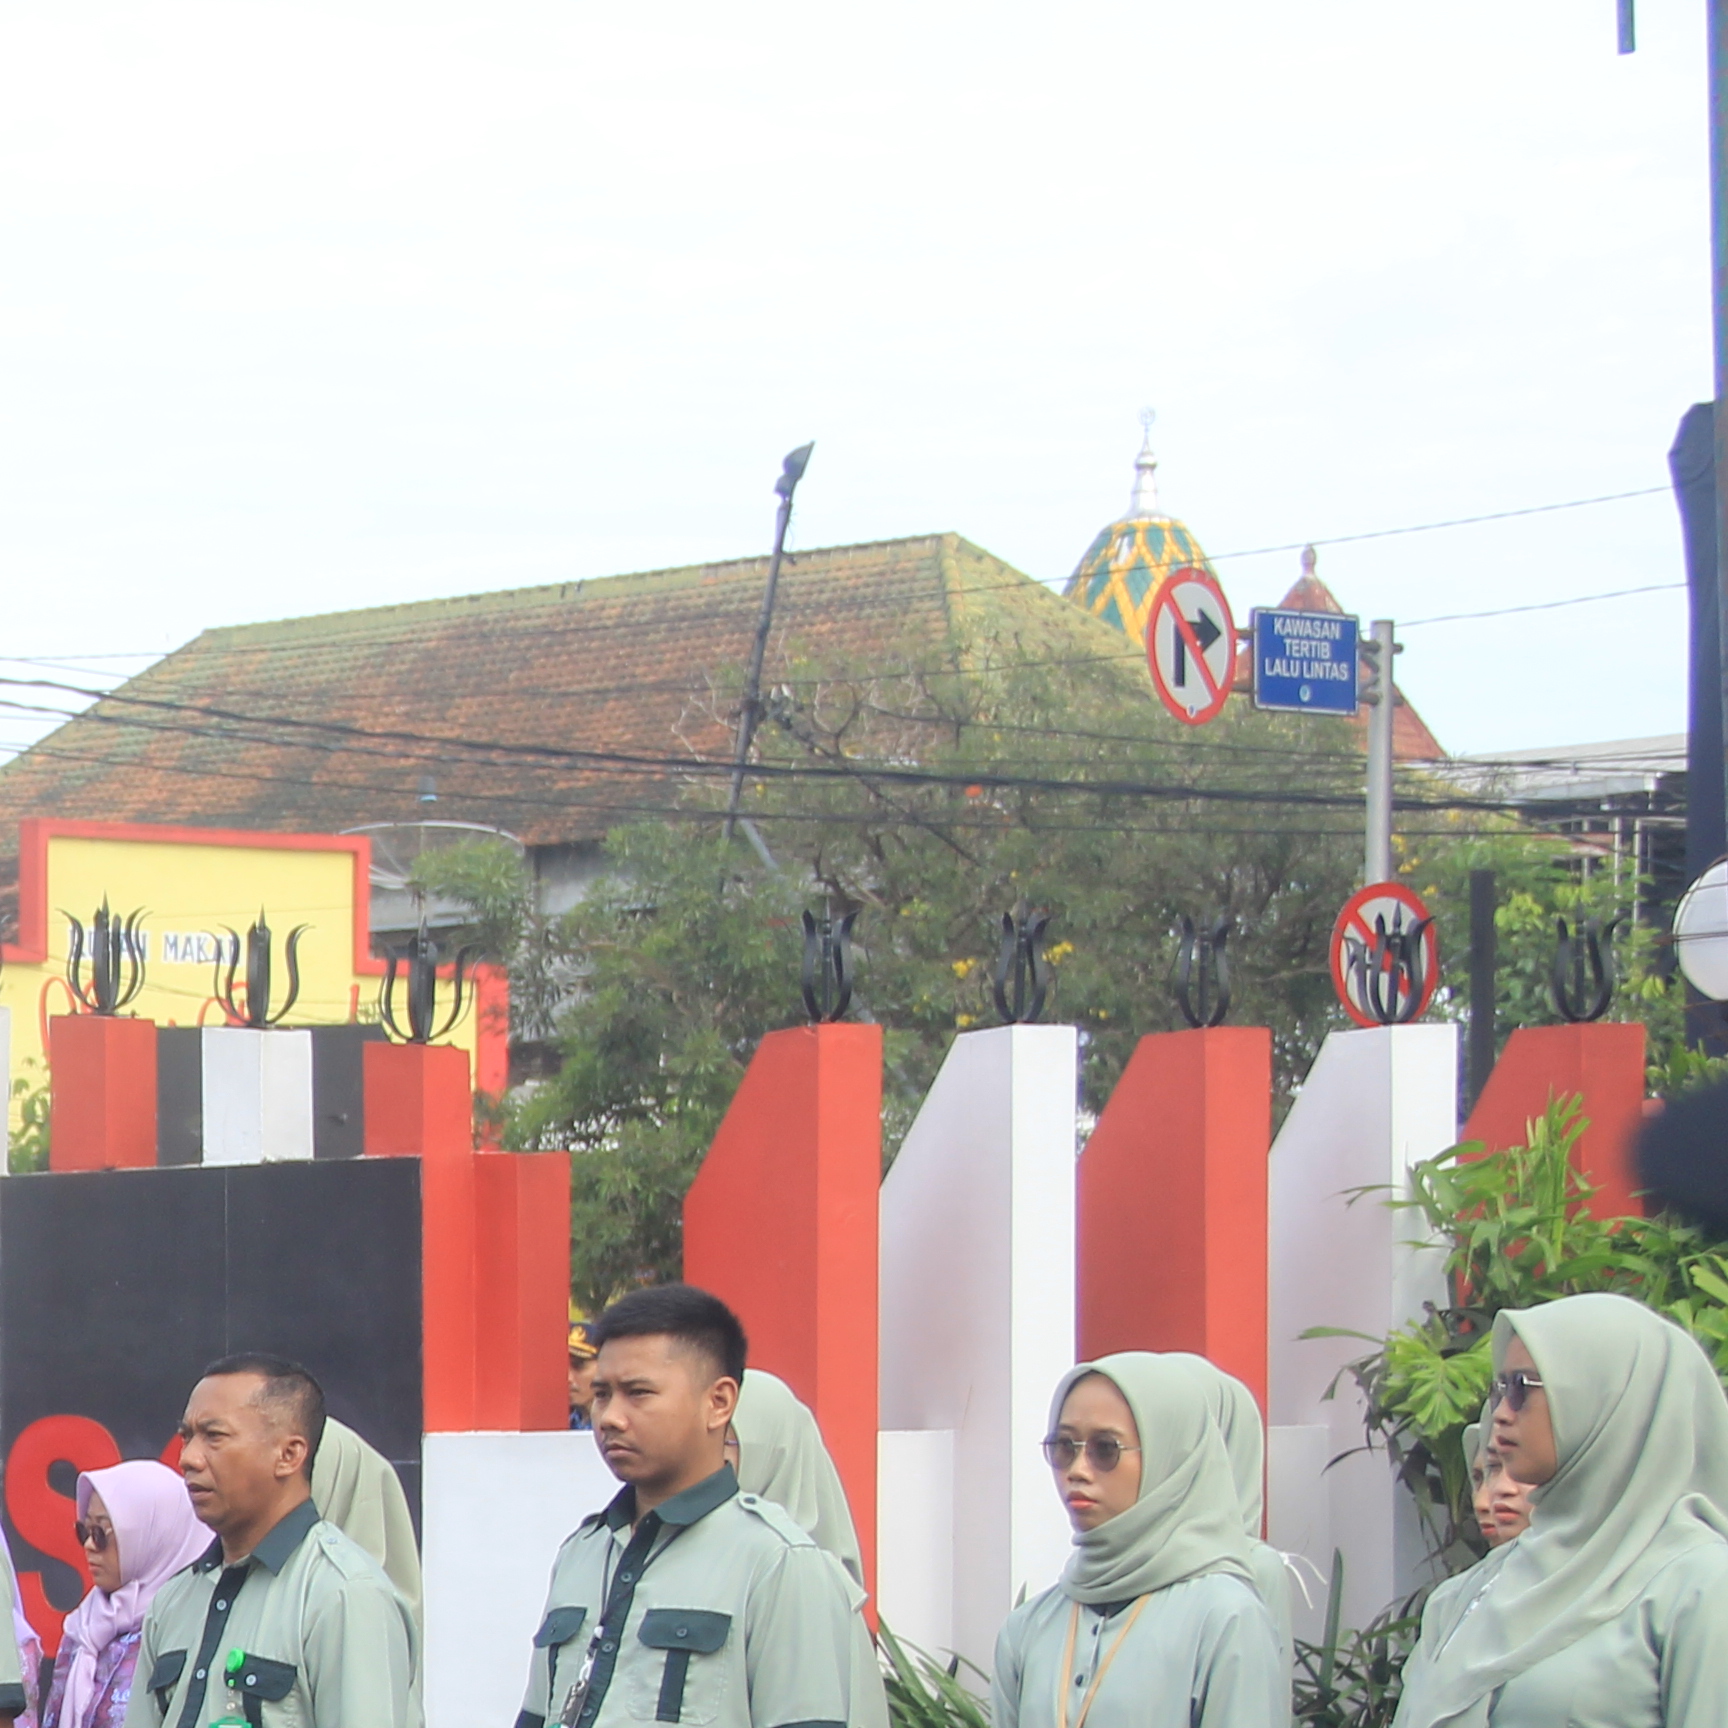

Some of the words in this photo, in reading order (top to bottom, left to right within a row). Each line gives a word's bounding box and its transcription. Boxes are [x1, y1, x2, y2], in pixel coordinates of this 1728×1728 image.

[1274, 617, 1341, 639] KAWASAN
[1283, 638, 1330, 659] TERTIB
[1265, 657, 1299, 678] LALU
[1303, 660, 1349, 681] LINTAS
